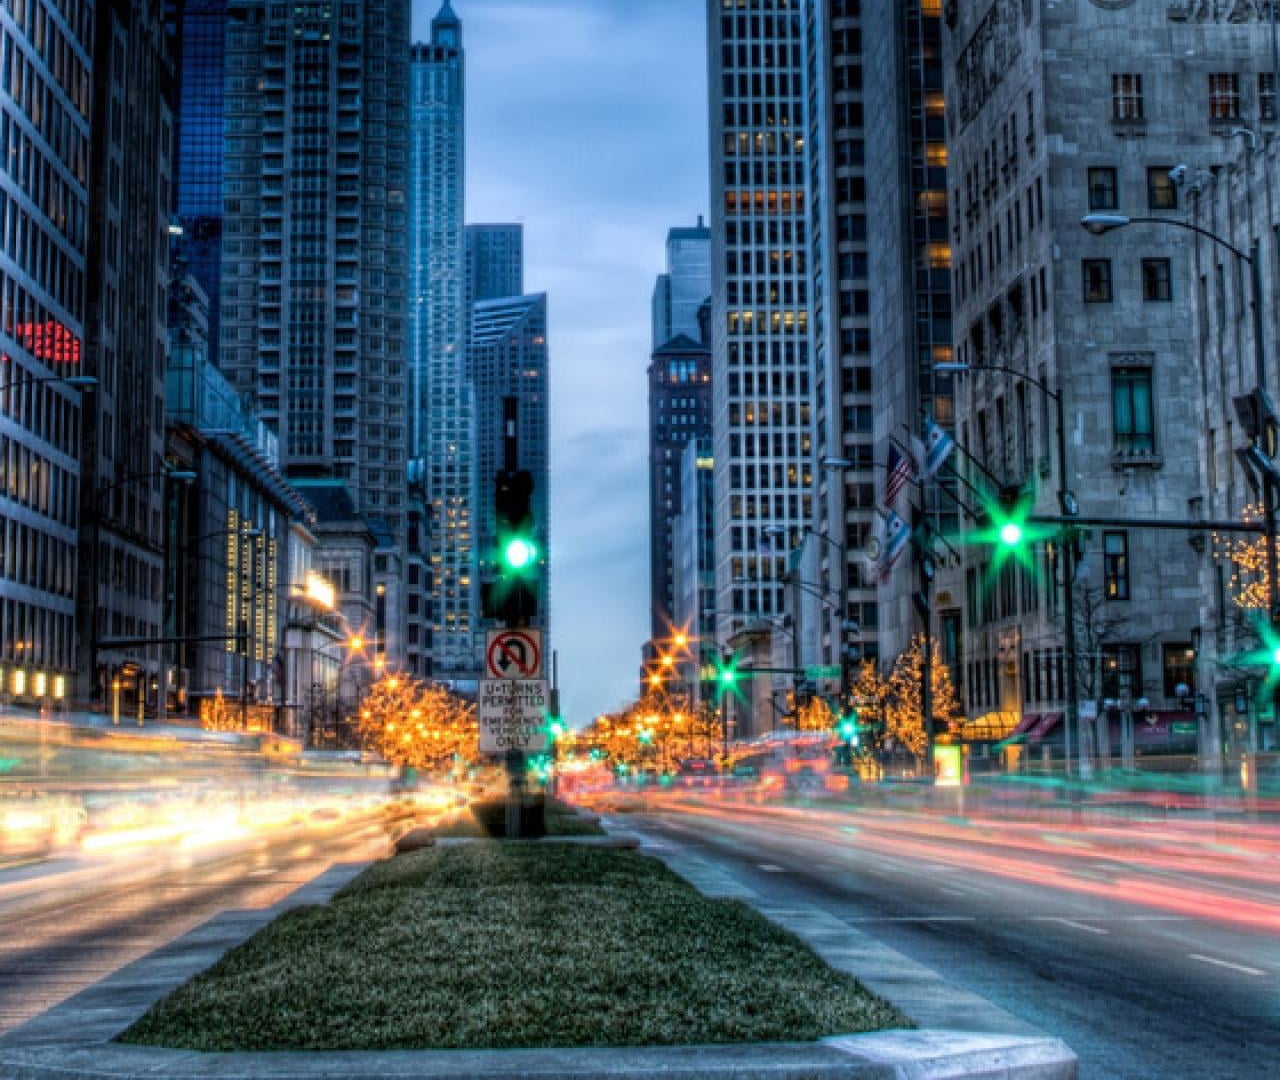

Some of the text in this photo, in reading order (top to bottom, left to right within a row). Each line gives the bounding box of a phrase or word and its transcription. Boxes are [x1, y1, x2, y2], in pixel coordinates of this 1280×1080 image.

[485, 683, 543, 695] U-TURNS
[482, 696, 544, 706] PERMITTED
[482, 716, 544, 726] EMERGENCY
[496, 736, 531, 747] ONLY
